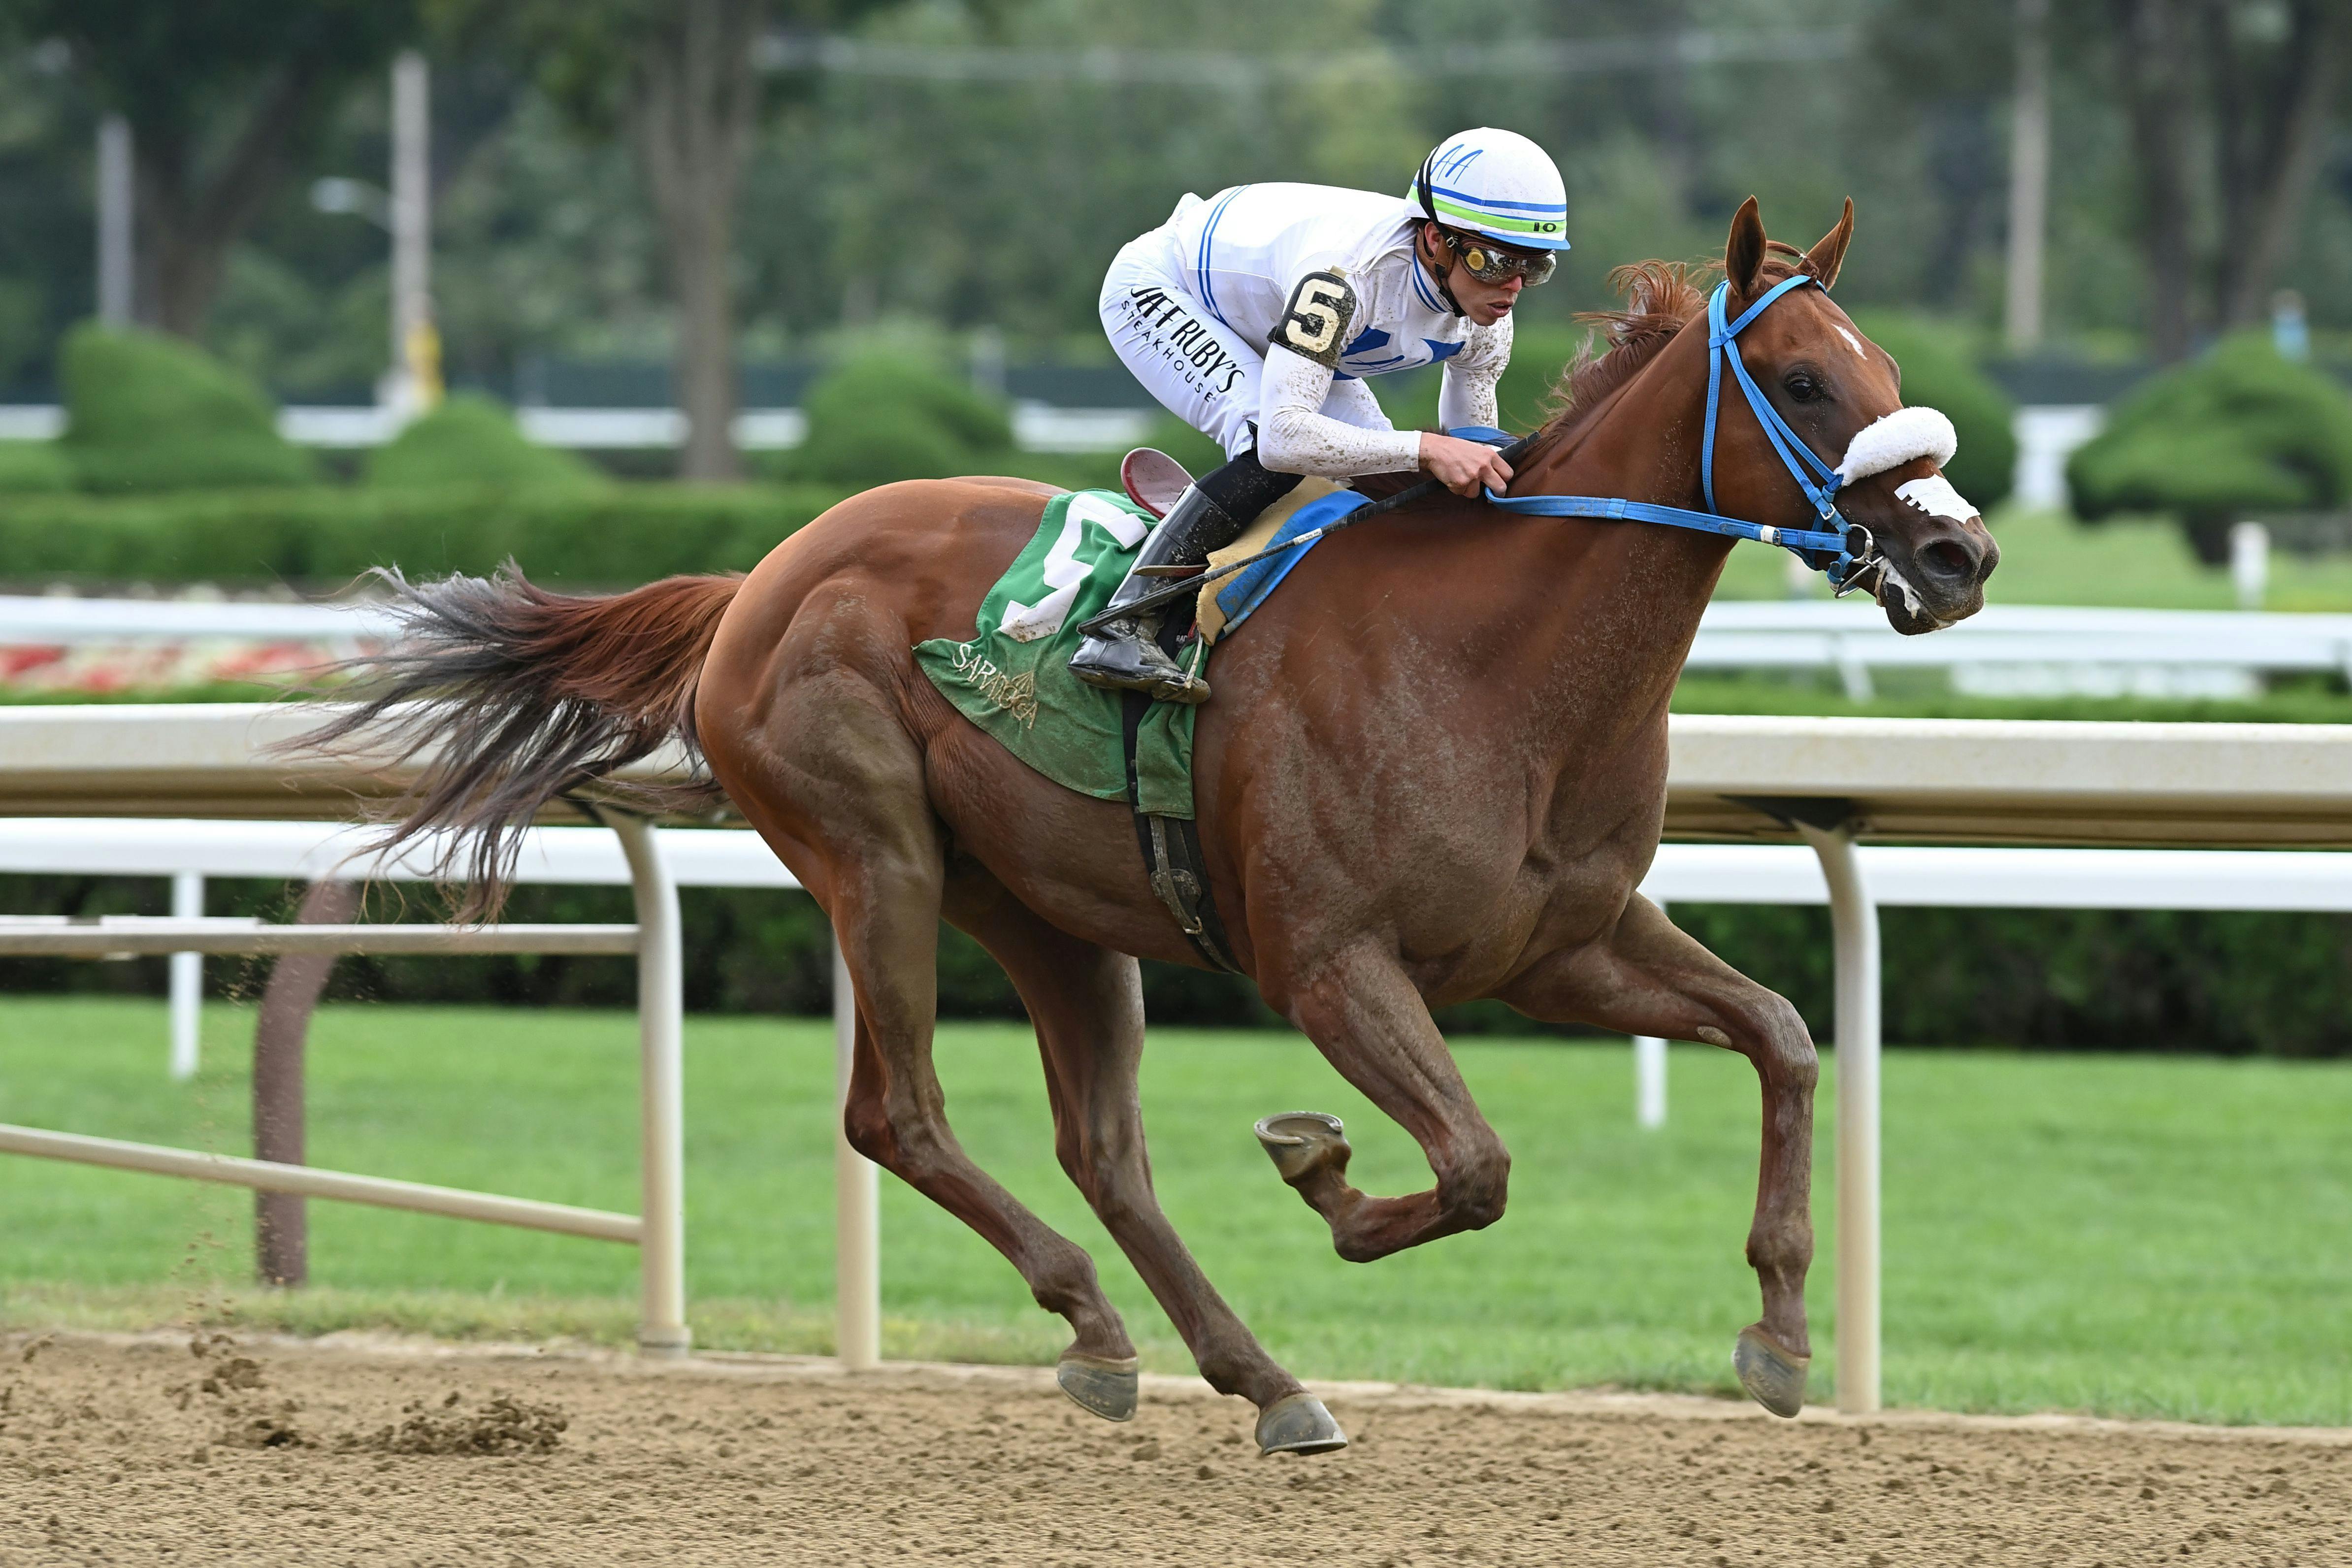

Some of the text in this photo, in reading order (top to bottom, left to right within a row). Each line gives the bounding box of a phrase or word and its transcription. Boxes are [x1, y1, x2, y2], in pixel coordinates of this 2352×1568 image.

[1121, 300, 1213, 403] STEAKHOUSE
[1170, 318, 1245, 393] RUBY'S
[1285, 278, 1345, 353] 5
[998, 493, 1149, 643] 5
